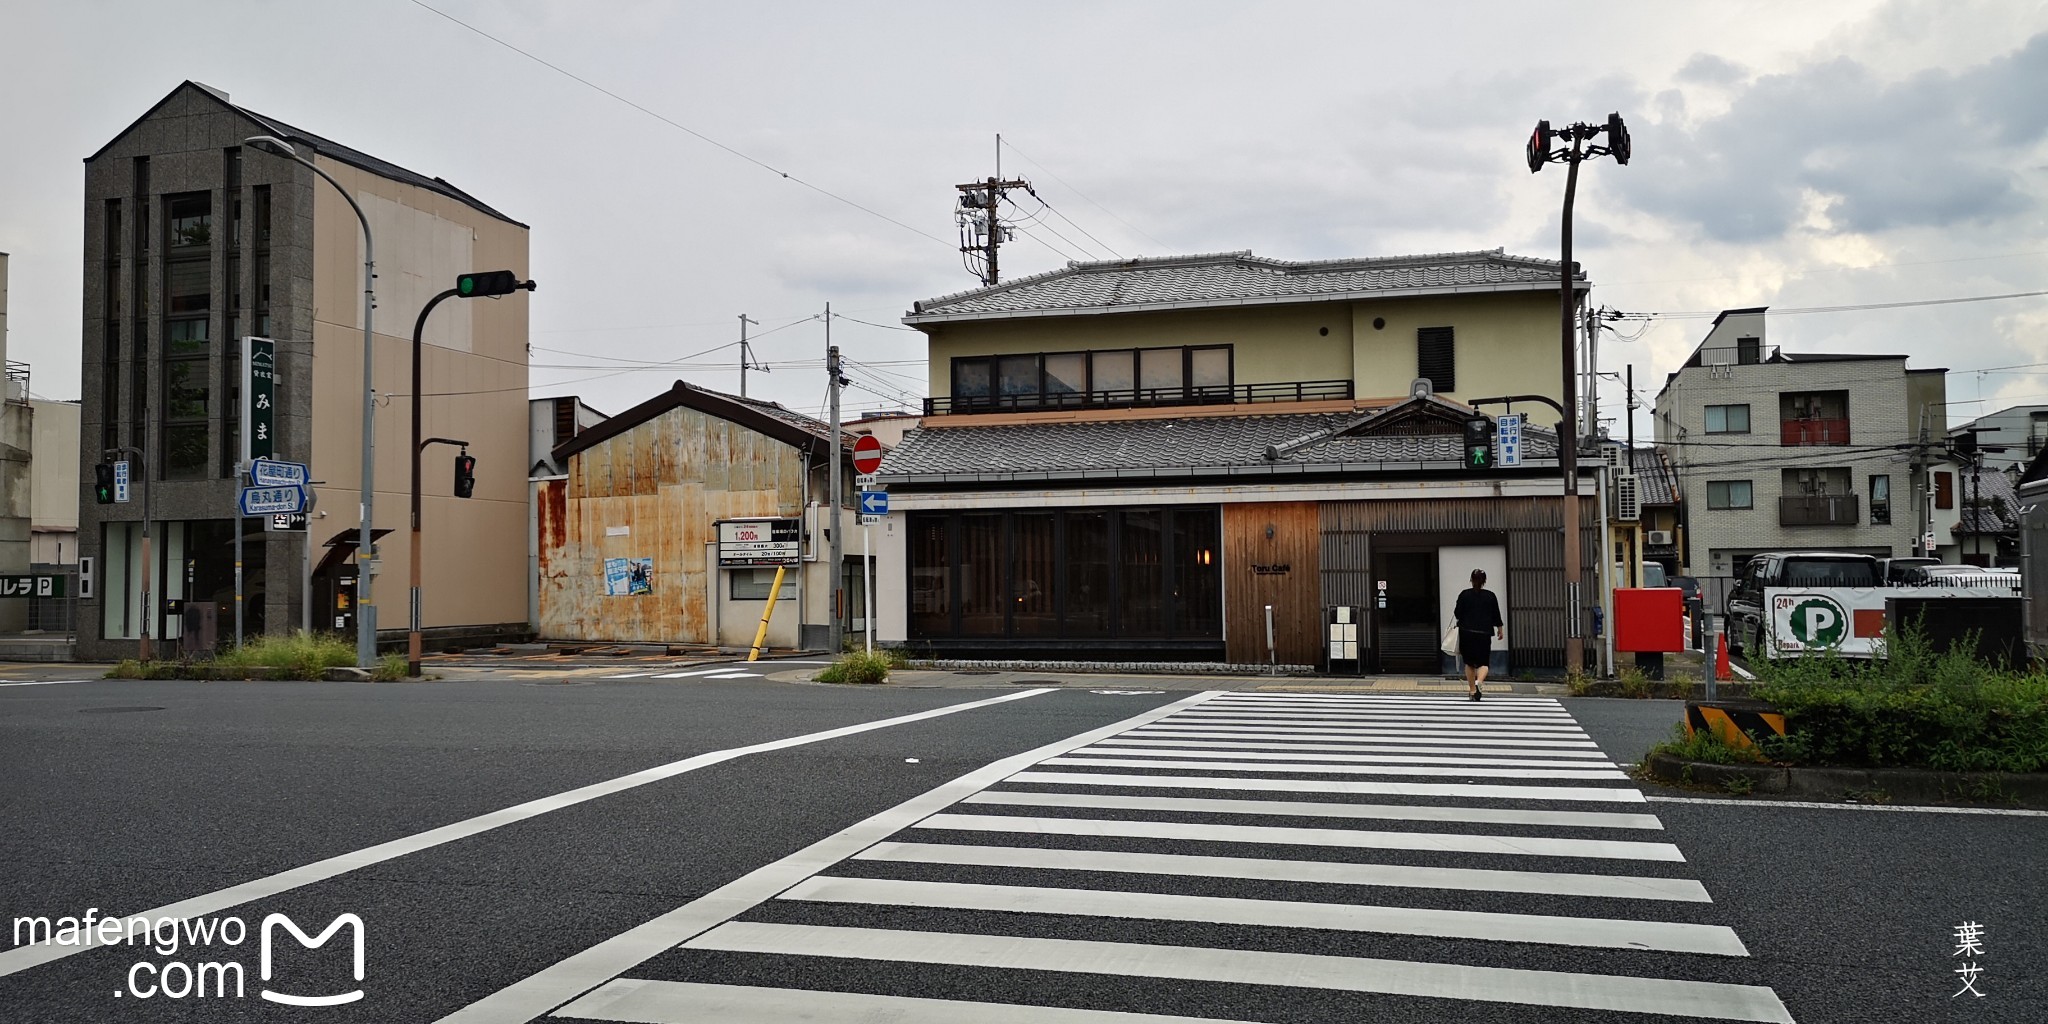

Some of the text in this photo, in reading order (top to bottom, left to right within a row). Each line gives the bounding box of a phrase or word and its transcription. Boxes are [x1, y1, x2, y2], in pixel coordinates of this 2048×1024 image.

[1500, 419, 1508, 444] 自転車
[1509, 418, 1517, 444] 歩行者
[1506, 446, 1514, 463] 専用
[259, 463, 301, 480] 花屋町通り
[251, 489, 294, 504] 烏丸通り
[0, 578, 32, 595] レラ
[1805, 606, 1835, 642] P
